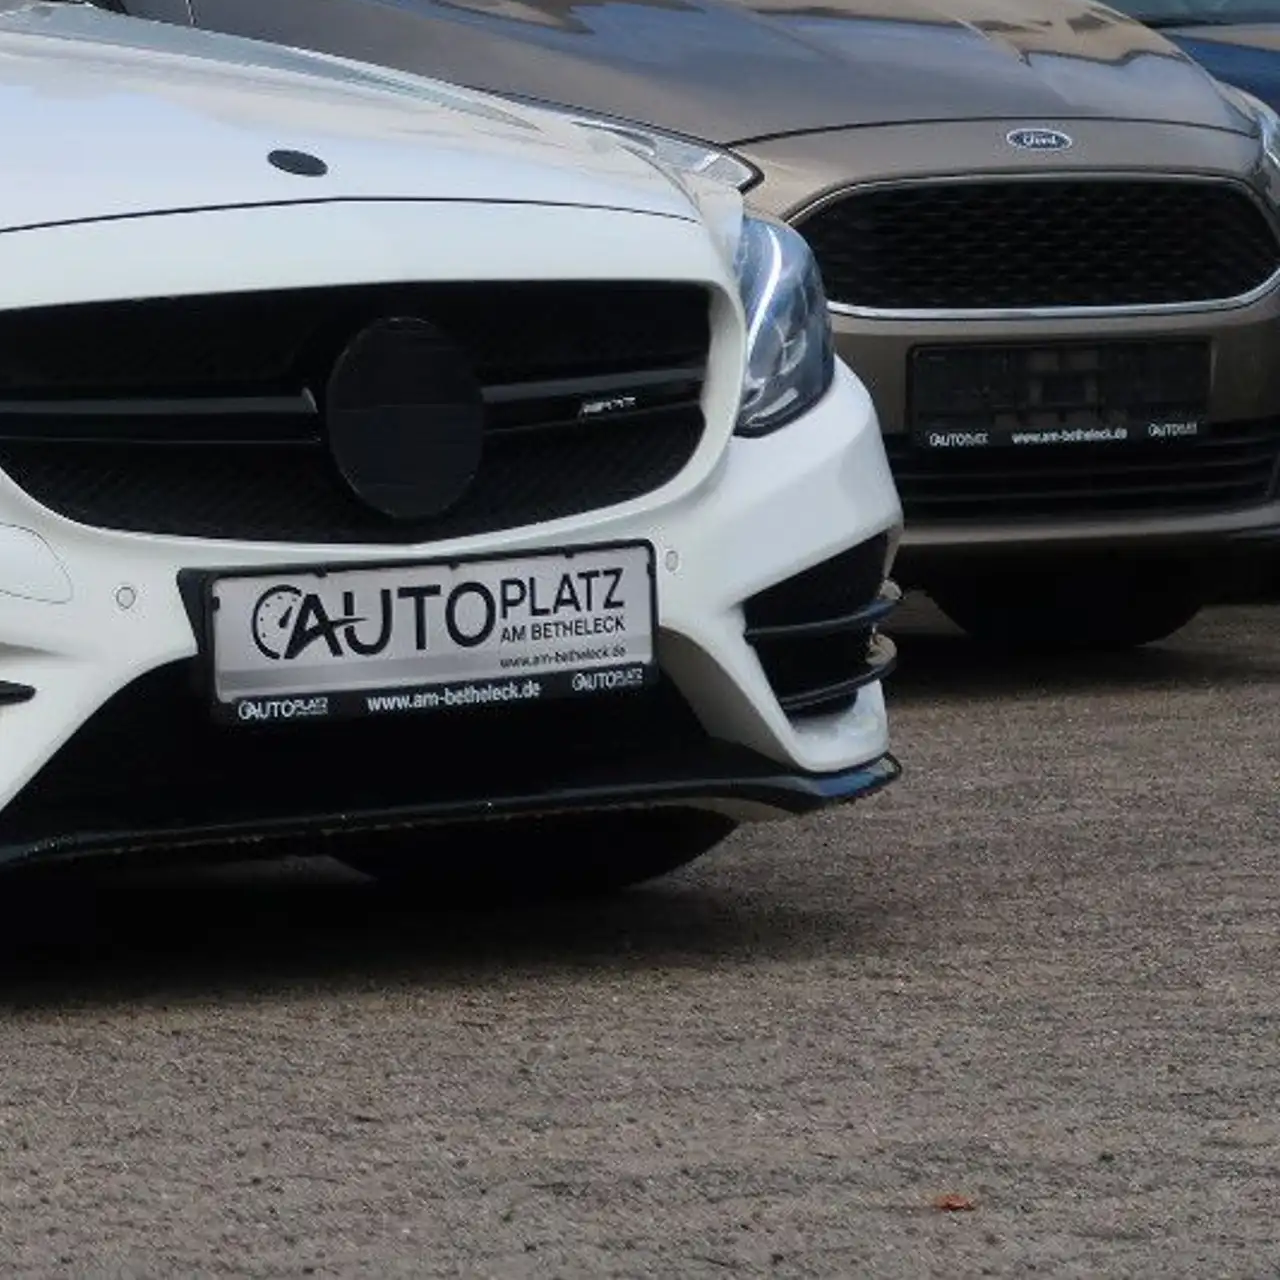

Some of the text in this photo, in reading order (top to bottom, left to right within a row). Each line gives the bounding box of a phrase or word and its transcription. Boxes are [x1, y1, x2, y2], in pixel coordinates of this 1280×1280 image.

[285, 568, 627, 659] AUTOPLATZ
[500, 616, 626, 643] AM BETHELECK
[367, 680, 541, 713] www.am-betheleck.de
